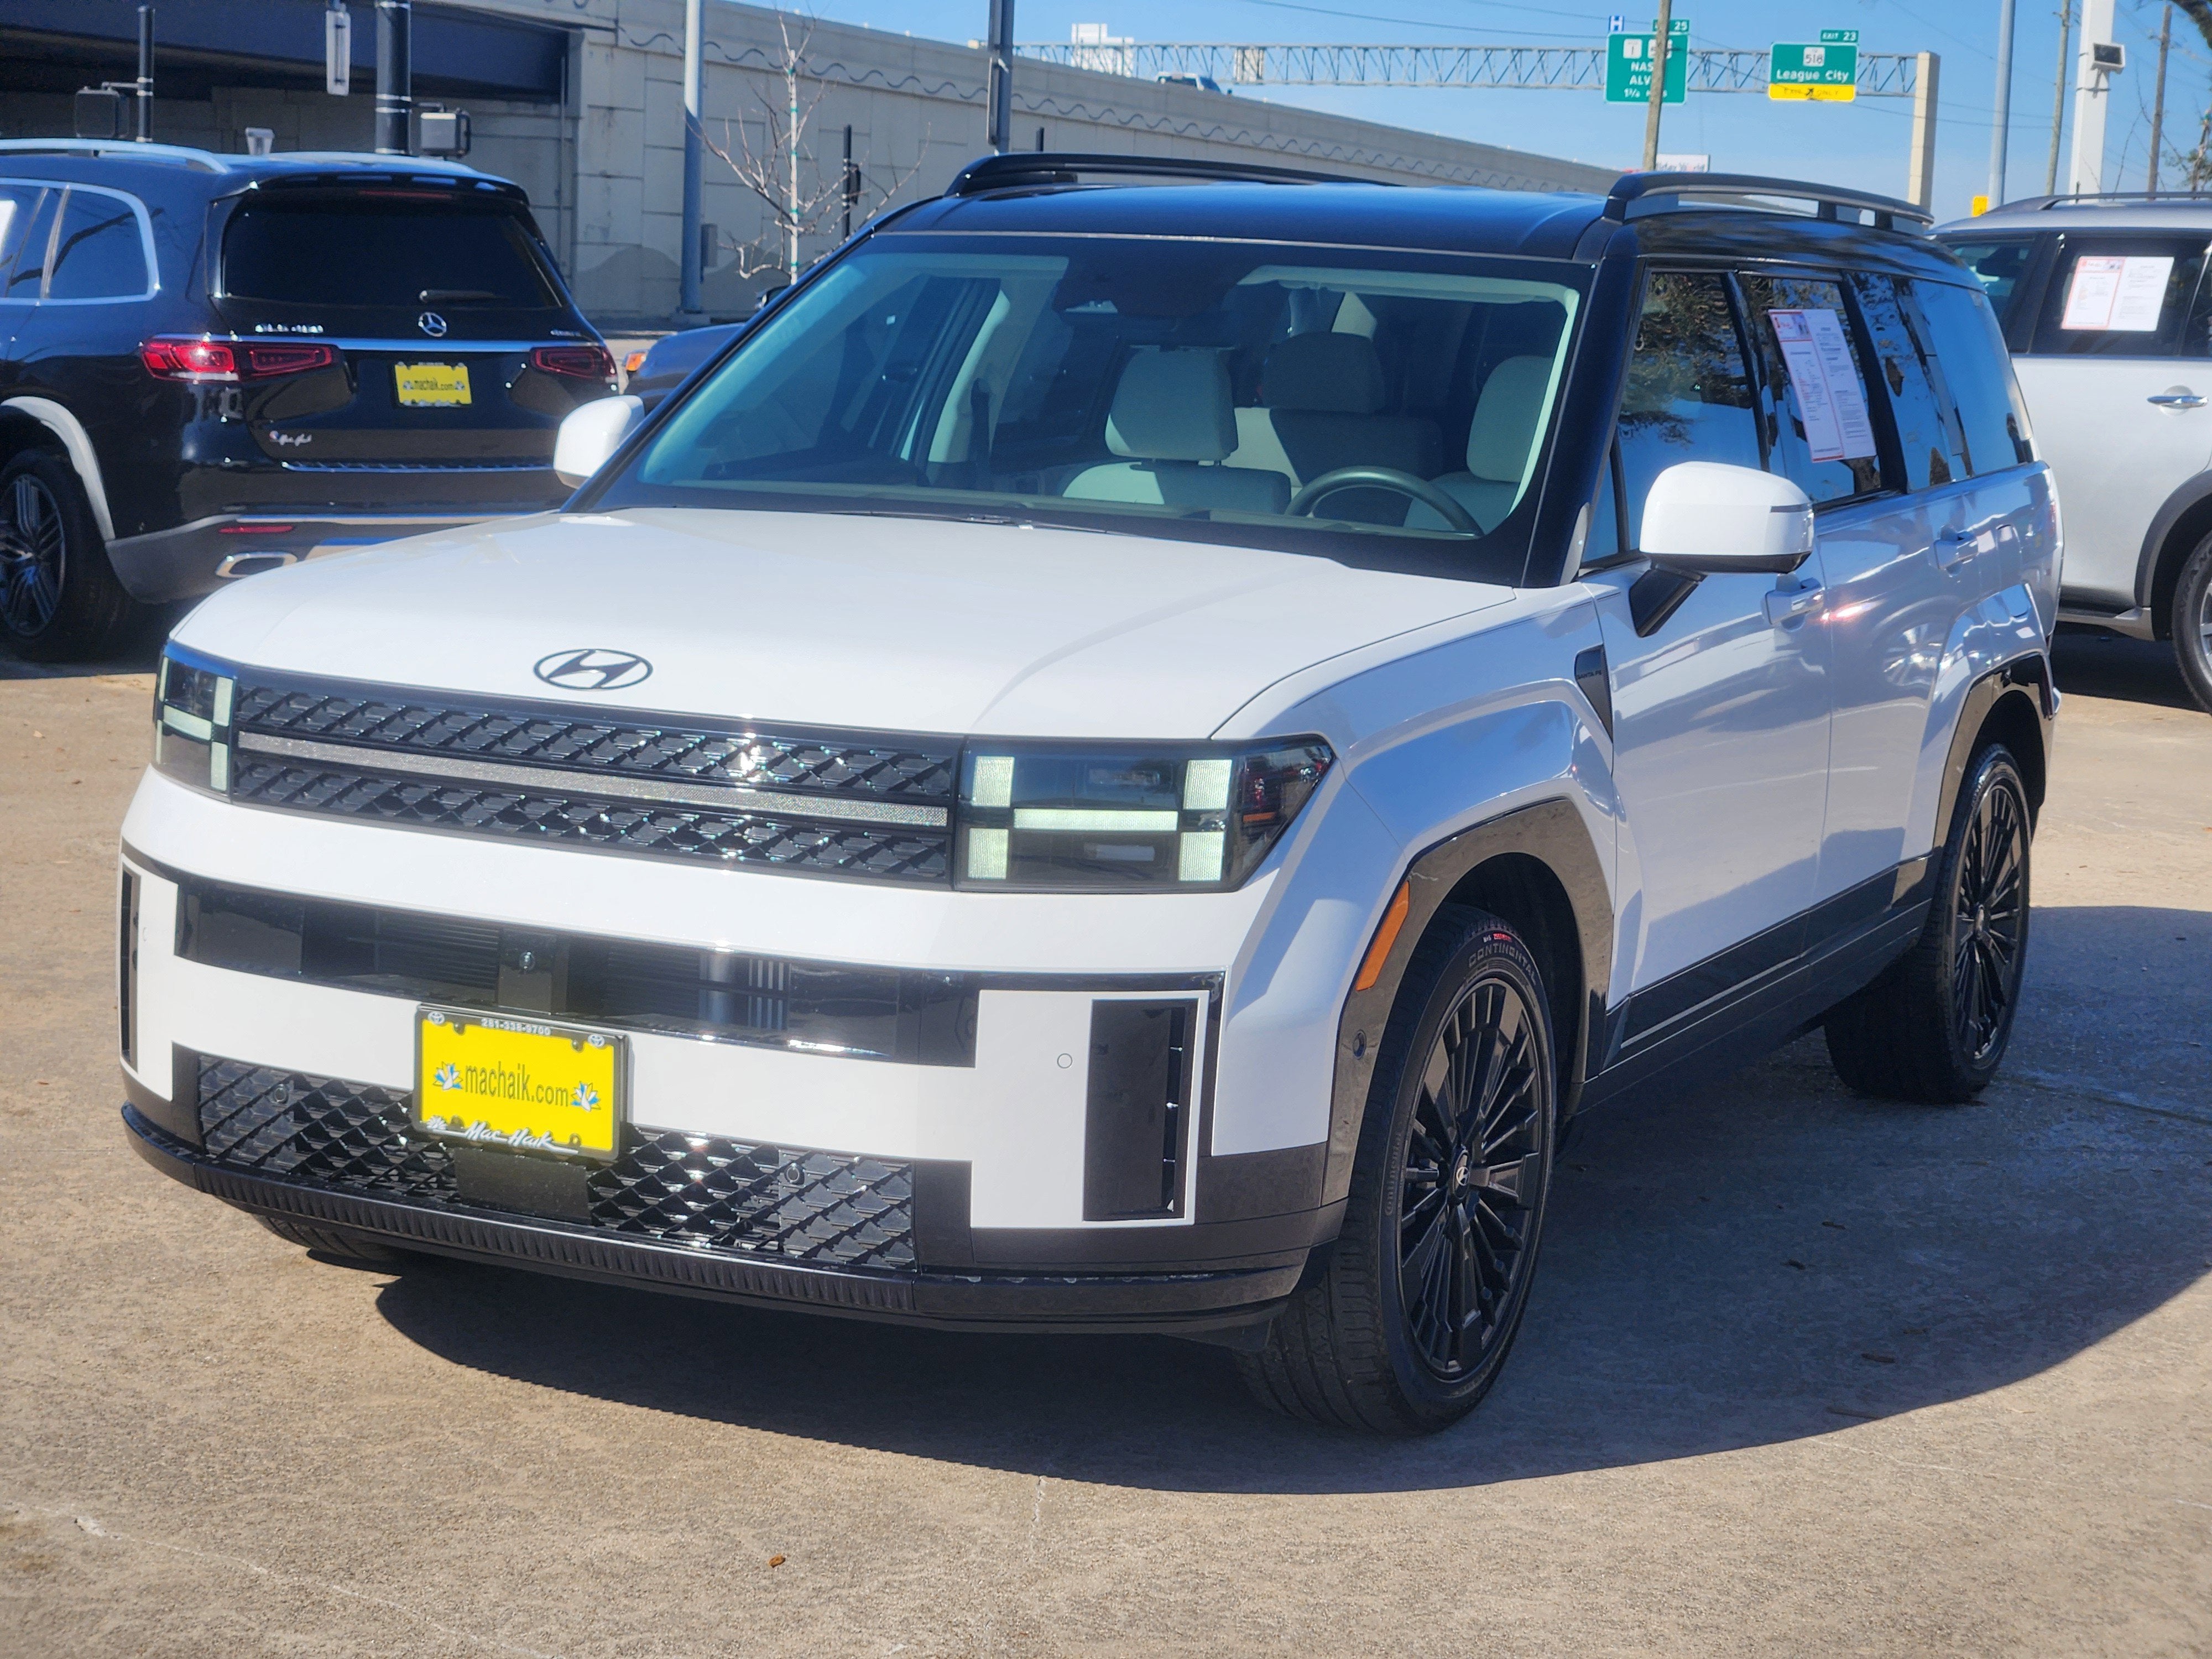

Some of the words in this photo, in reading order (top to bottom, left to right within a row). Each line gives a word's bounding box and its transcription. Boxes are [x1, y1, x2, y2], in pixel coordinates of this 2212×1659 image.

[1843, 32, 1857, 41] 23
[1631, 61, 1656, 71] NAS
[1629, 75, 1655, 85] ALV
[1776, 69, 1820, 82] League
[1825, 70, 1849, 82] City
[465, 1061, 569, 1107] machaik.com
[466, 1119, 504, 1141] Mac
